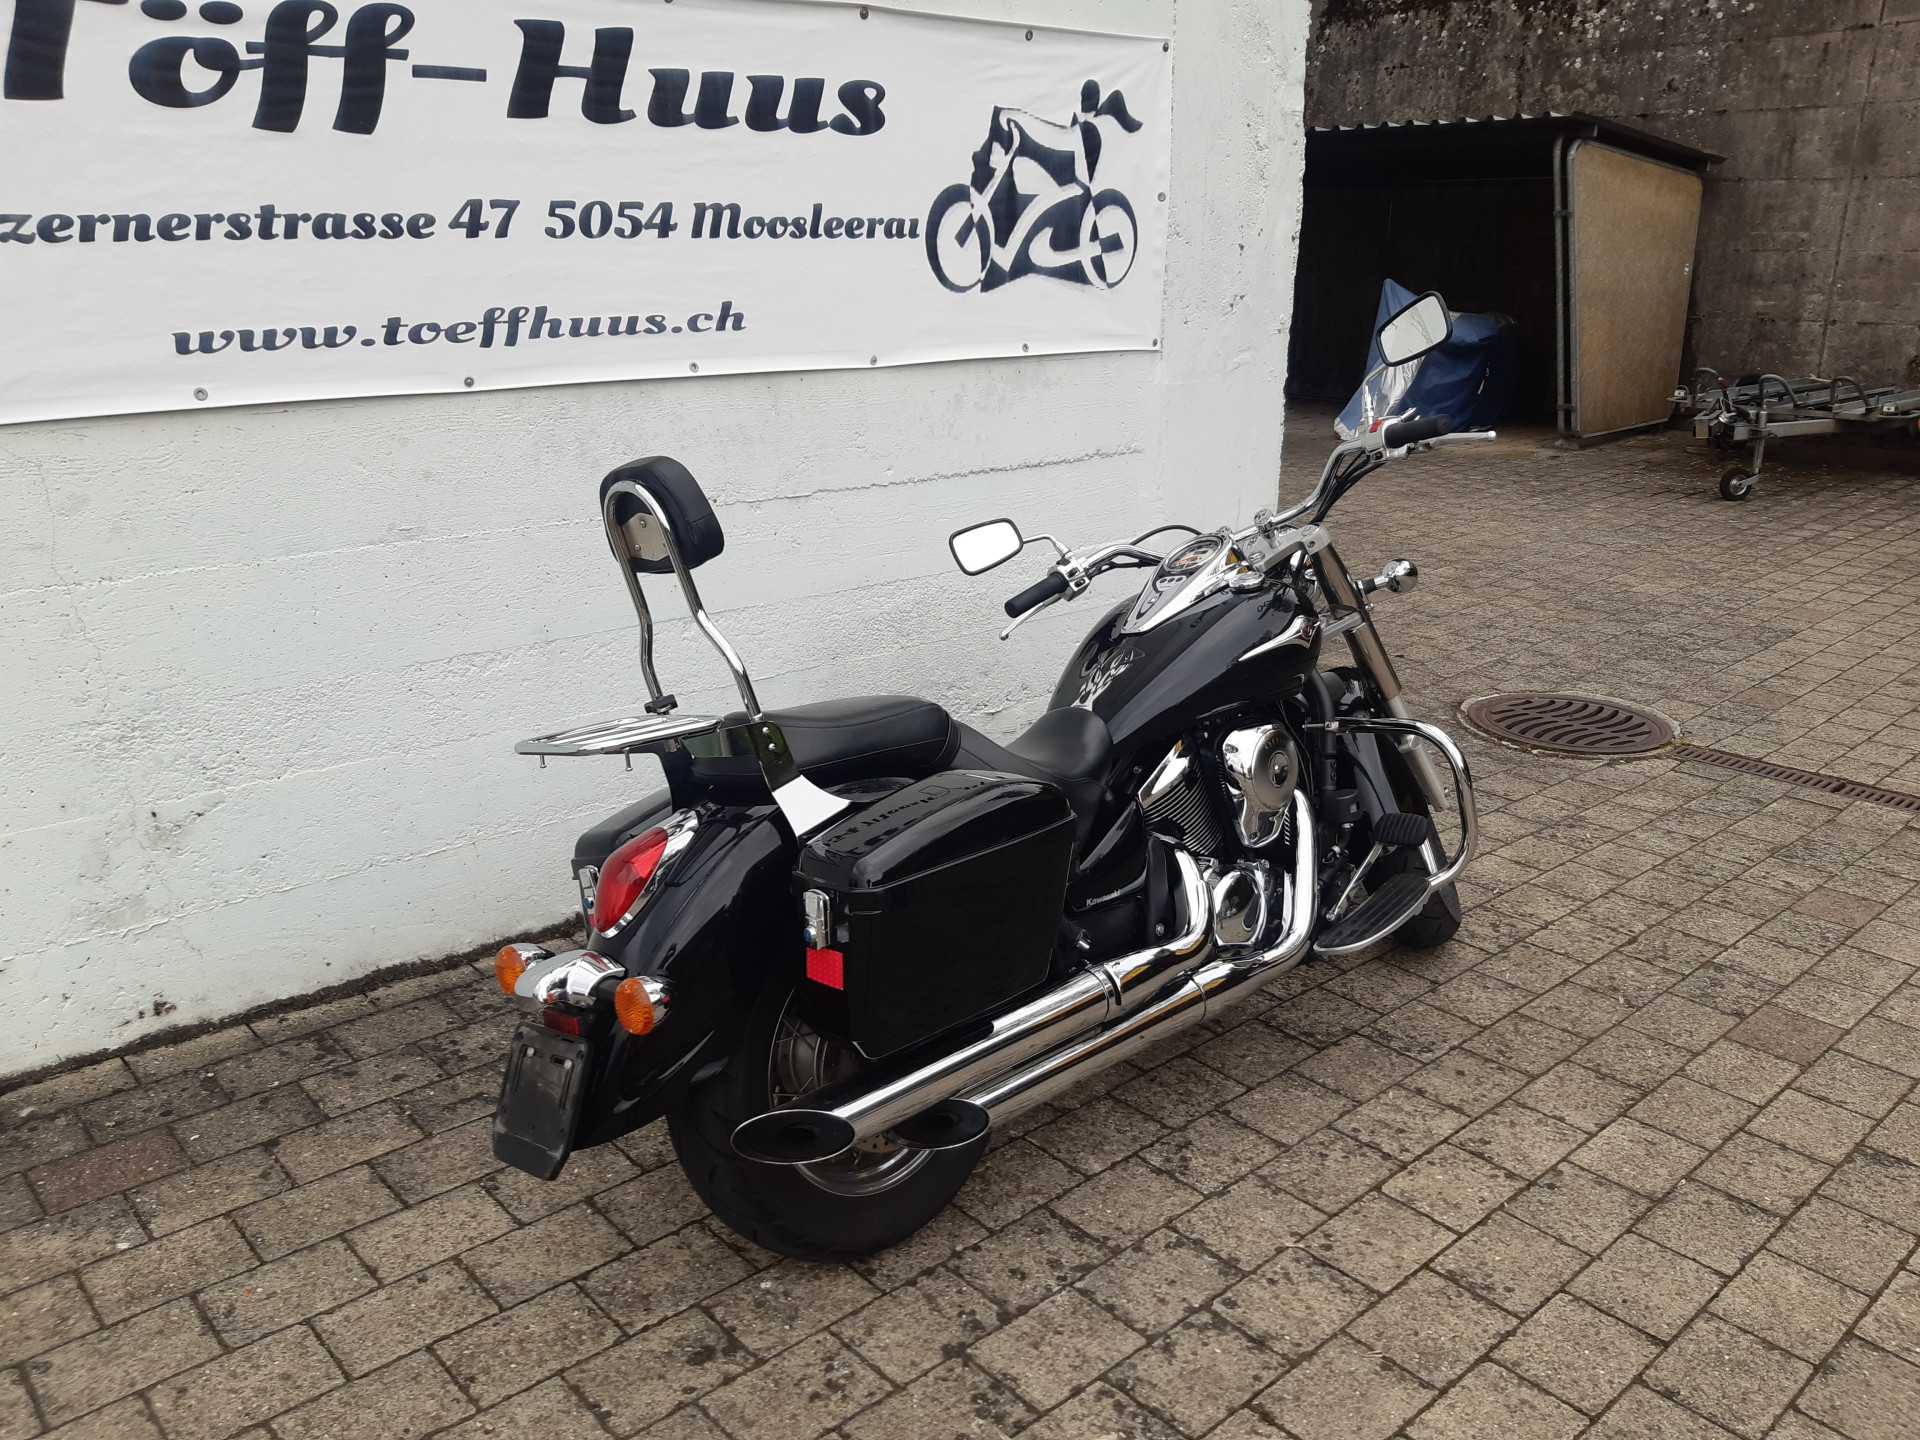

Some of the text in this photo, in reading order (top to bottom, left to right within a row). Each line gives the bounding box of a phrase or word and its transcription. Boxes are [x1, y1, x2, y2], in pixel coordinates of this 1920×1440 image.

[447, 198, 521, 239] 47
[544, 200, 678, 240] 5054
[171, 300, 747, 356] www.toeffhuus.ch
